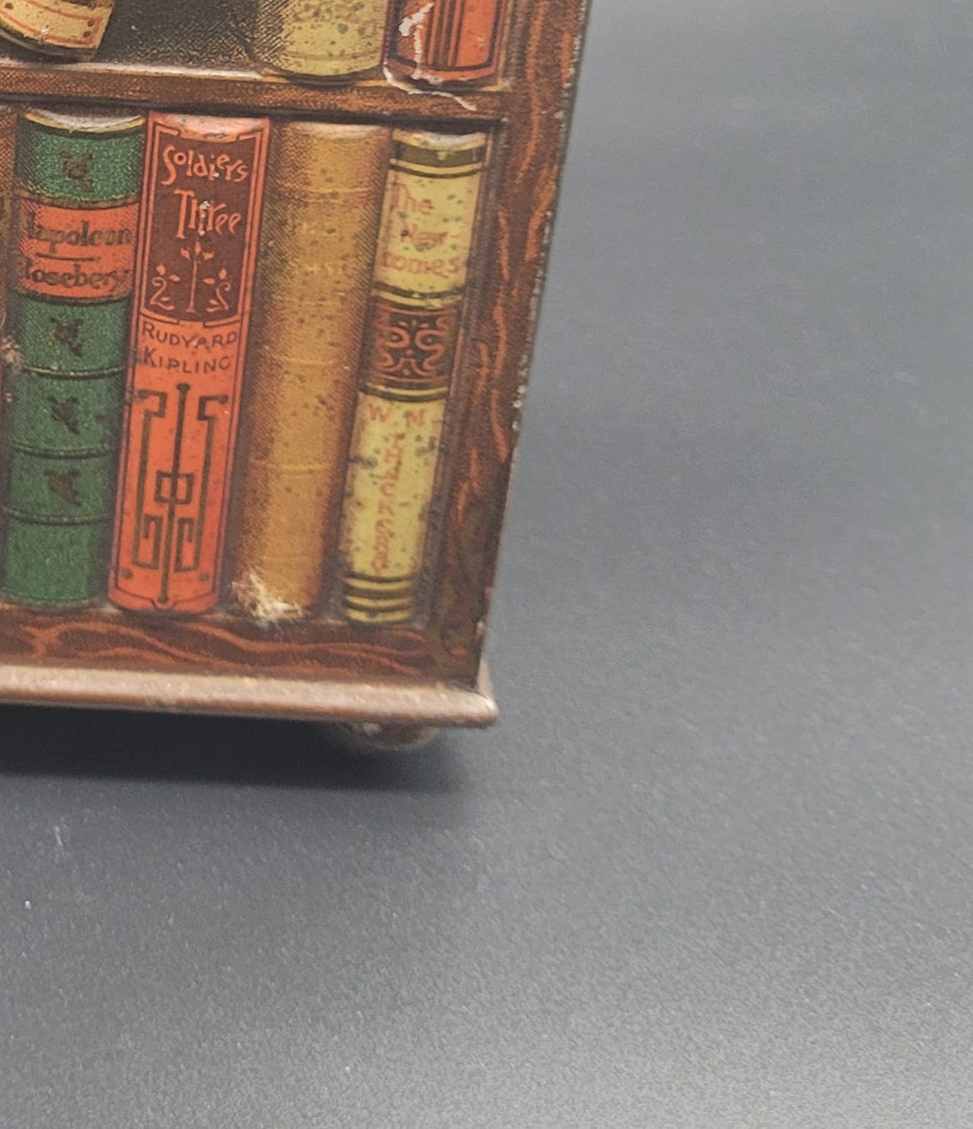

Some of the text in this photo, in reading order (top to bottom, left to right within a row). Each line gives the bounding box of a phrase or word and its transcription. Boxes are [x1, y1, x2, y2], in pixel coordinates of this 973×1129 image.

[160, 143, 248, 187] Soldiers
[173, 188, 242, 240] Three
[142, 320, 239, 352] RUDYARD
[143, 345, 233, 375] KIPLING
